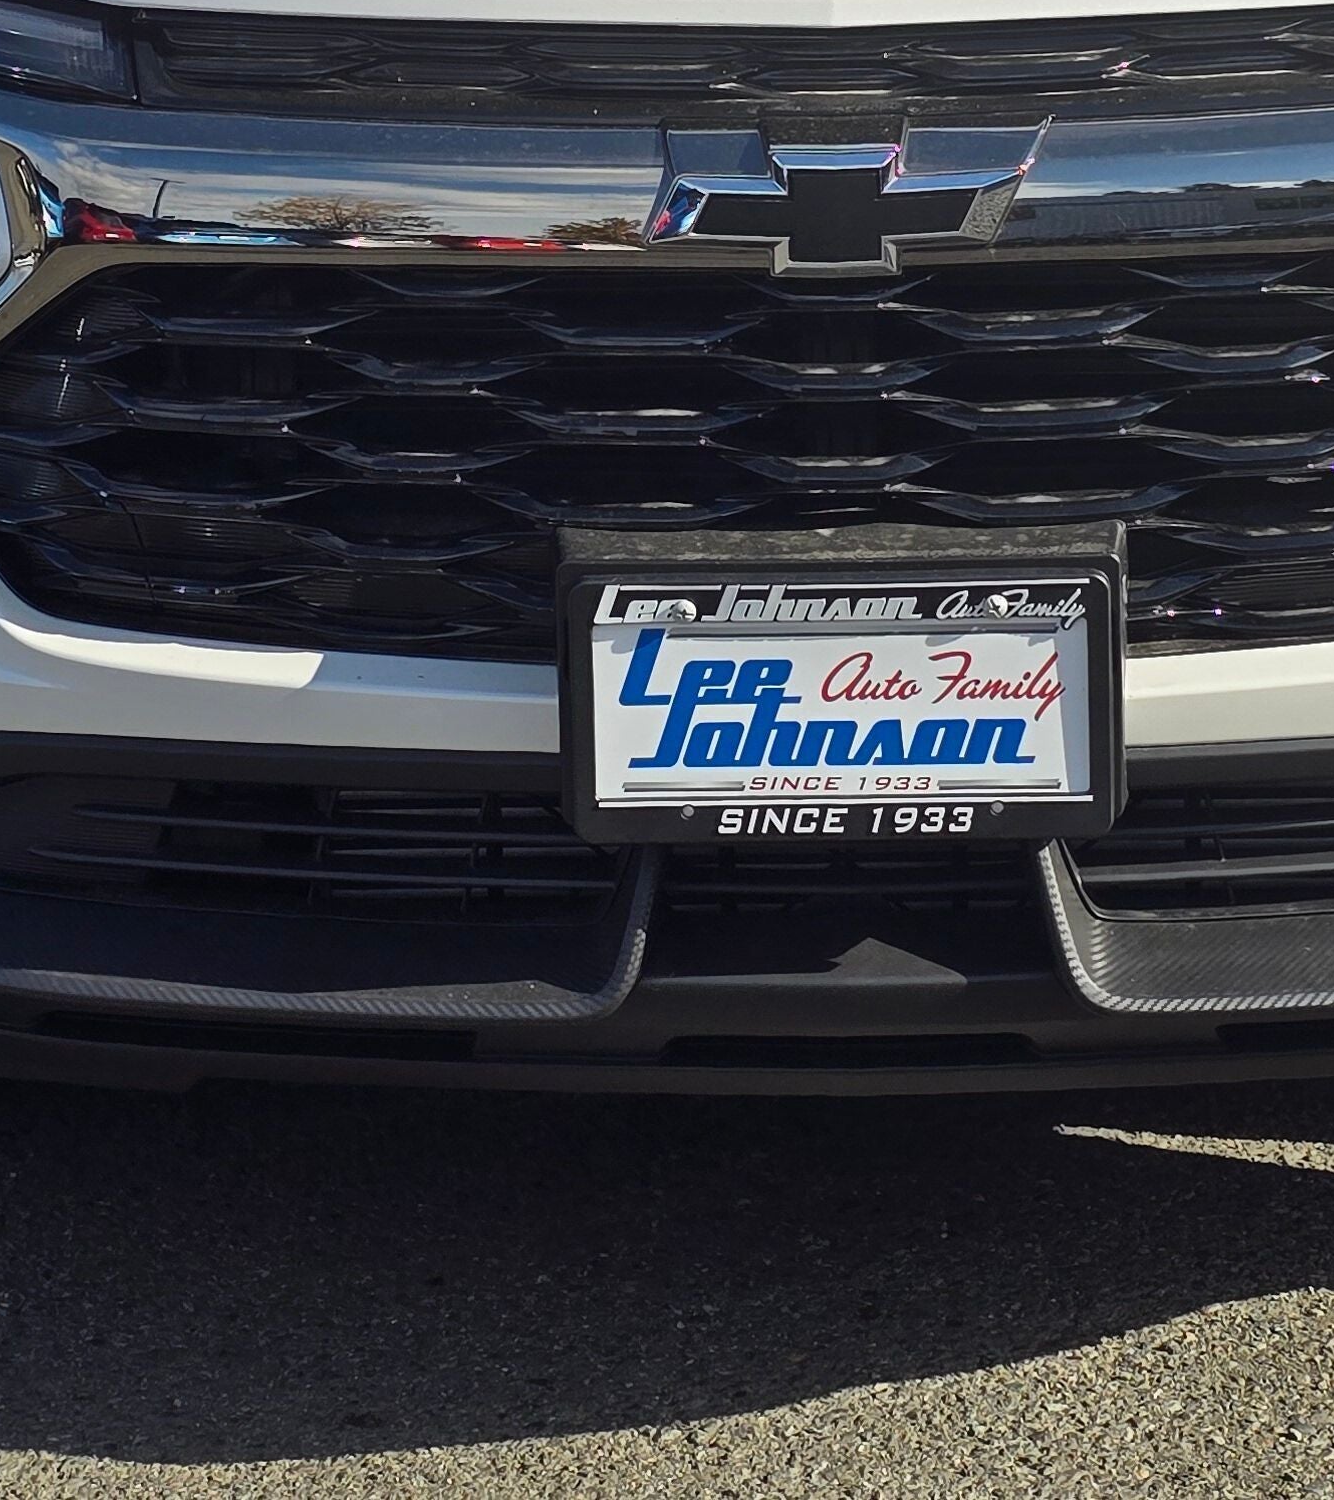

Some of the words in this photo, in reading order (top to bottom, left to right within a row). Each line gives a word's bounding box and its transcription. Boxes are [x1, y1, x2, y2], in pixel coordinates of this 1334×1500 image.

[701, 584, 922, 623] Johnson
[935, 589, 992, 621] Aut
[1001, 587, 1086, 630] Family
[619, 628, 802, 706] Lee
[820, 651, 923, 703] Auto
[927, 651, 1066, 722] Family
[628, 690, 1036, 768] Johnson
[749, 776, 843, 791] SINCE
[859, 776, 932, 791] 1933
[717, 807, 849, 835] SINCE
[871, 806, 974, 834] 1933
